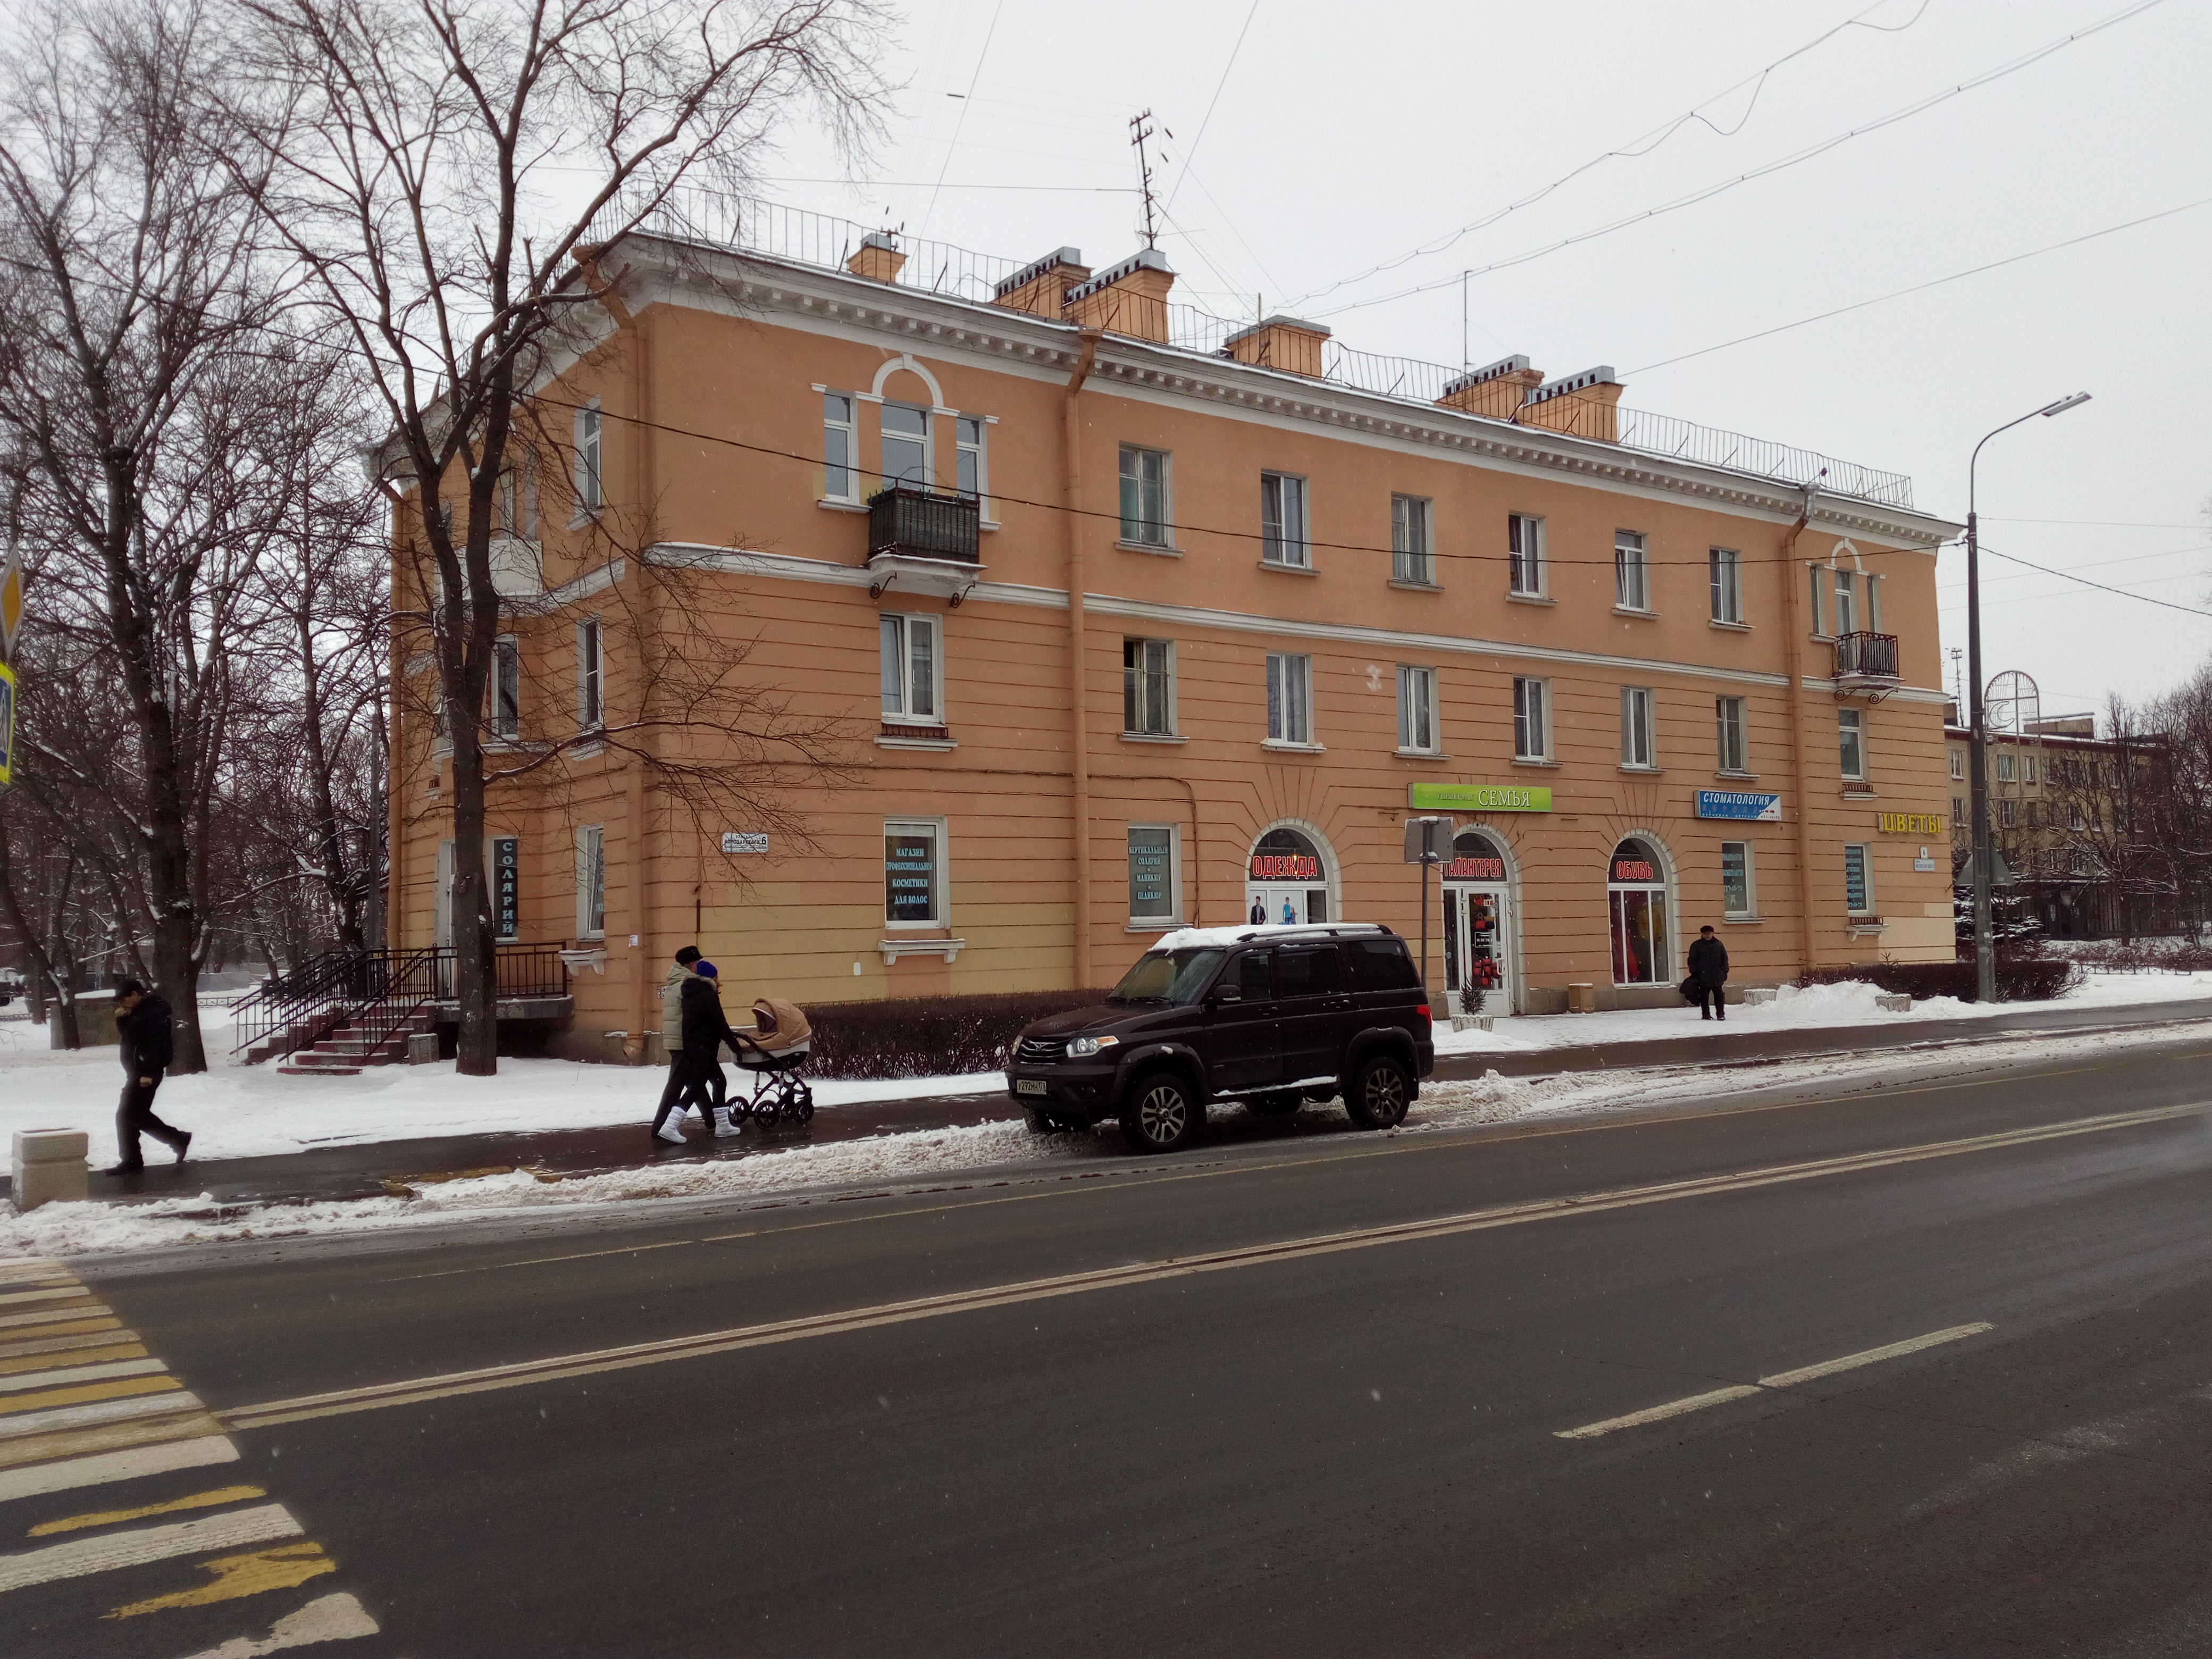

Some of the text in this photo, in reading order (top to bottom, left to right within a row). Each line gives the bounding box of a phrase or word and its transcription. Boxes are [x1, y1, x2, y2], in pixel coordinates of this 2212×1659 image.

[1478, 789, 1531, 807] СЕМЬЯ
[1704, 792, 1770, 806] СТОМАТОЛОГИЯ
[1882, 813, 1941, 833] ЦВЕТЫ
[761, 836, 766, 845] 6
[896, 848, 924, 857] МАГАЗИН
[1129, 845, 1168, 854] ВЕРТИКАЛЬНЫЙ
[1138, 856, 1161, 865] СОЛЯРИЙ
[1252, 855, 1317, 879] ОДЕЖДА
[1616, 860, 1653, 879] ОБУВЬ
[892, 878, 928, 887] КОСМЕТИКИ
[1136, 874, 1162, 882] МАНИКЮР
[502, 842, 514, 933] СОЛЯРИЙ
[894, 895, 907, 904] ДЛЯ
